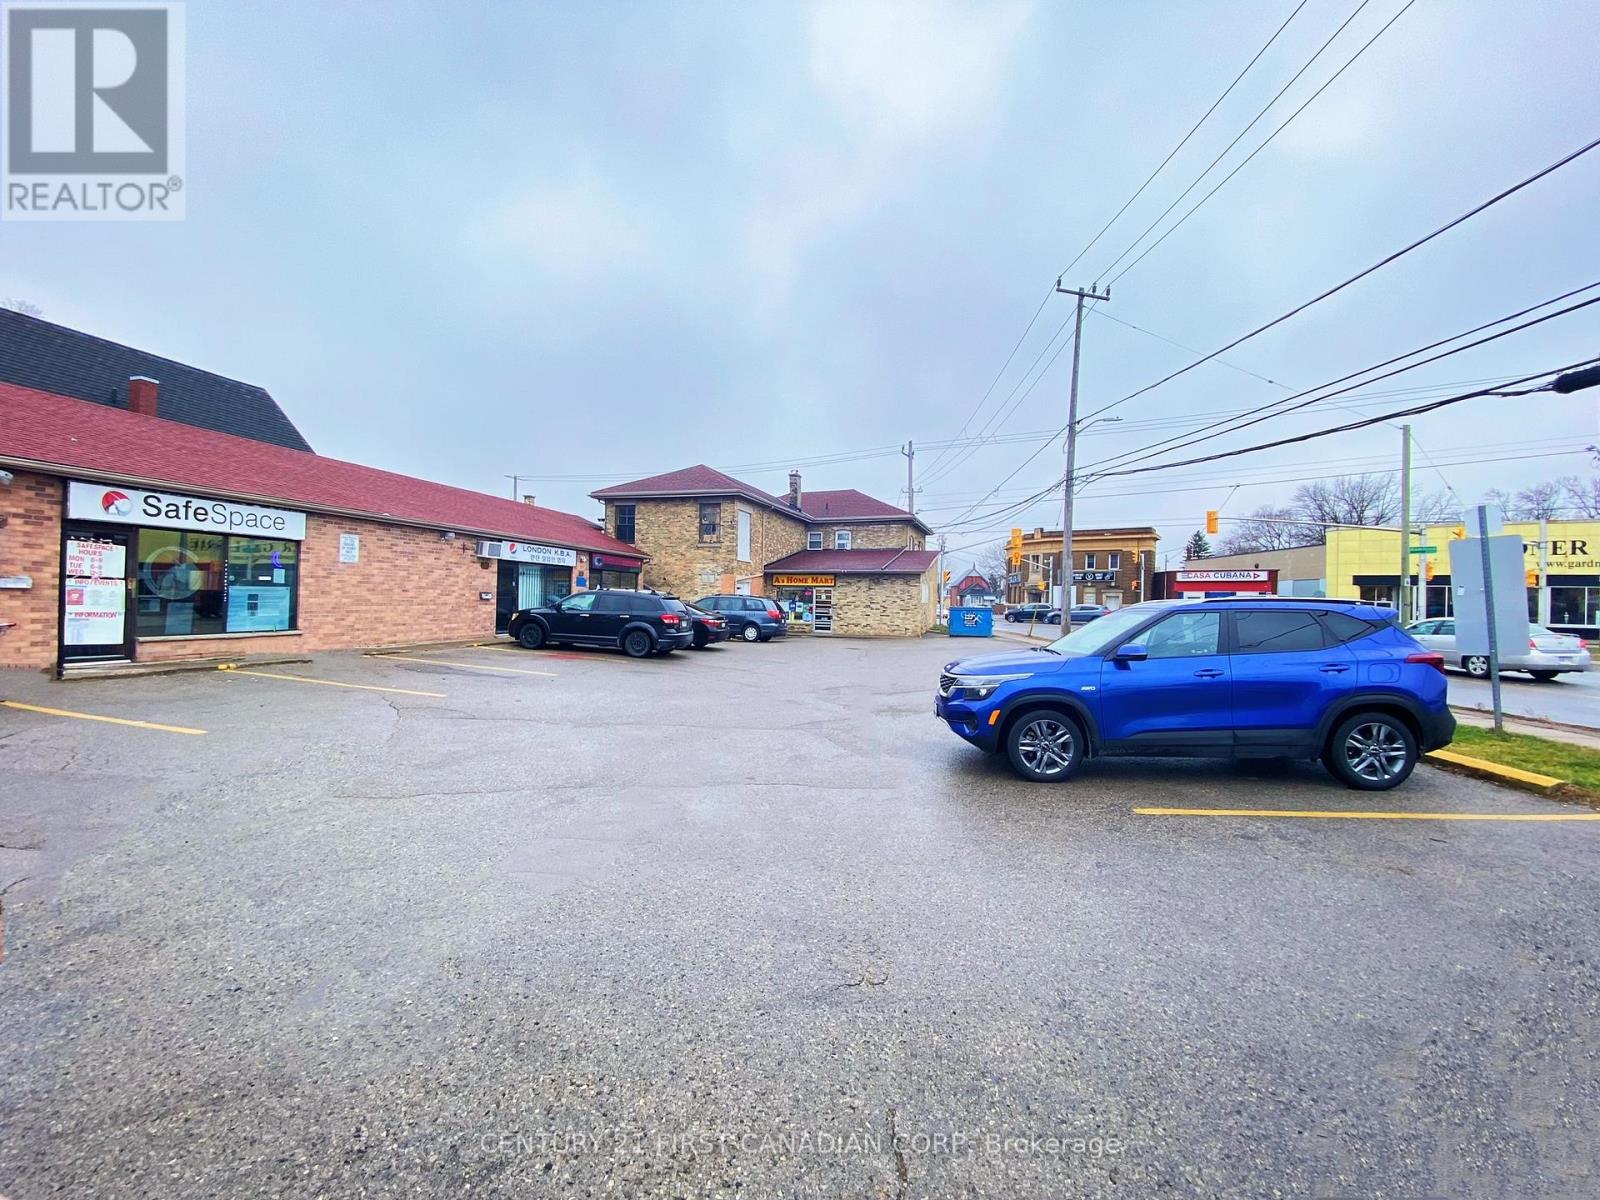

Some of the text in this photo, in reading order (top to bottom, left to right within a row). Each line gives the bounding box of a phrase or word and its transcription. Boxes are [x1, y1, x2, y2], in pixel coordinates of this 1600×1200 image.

[142, 494, 286, 531] SafeSpace
[522, 545, 552, 555] LONDON
[1523, 539, 1590, 556] ER
[787, 576, 809, 584] HOME
[811, 576, 833, 584] MART
